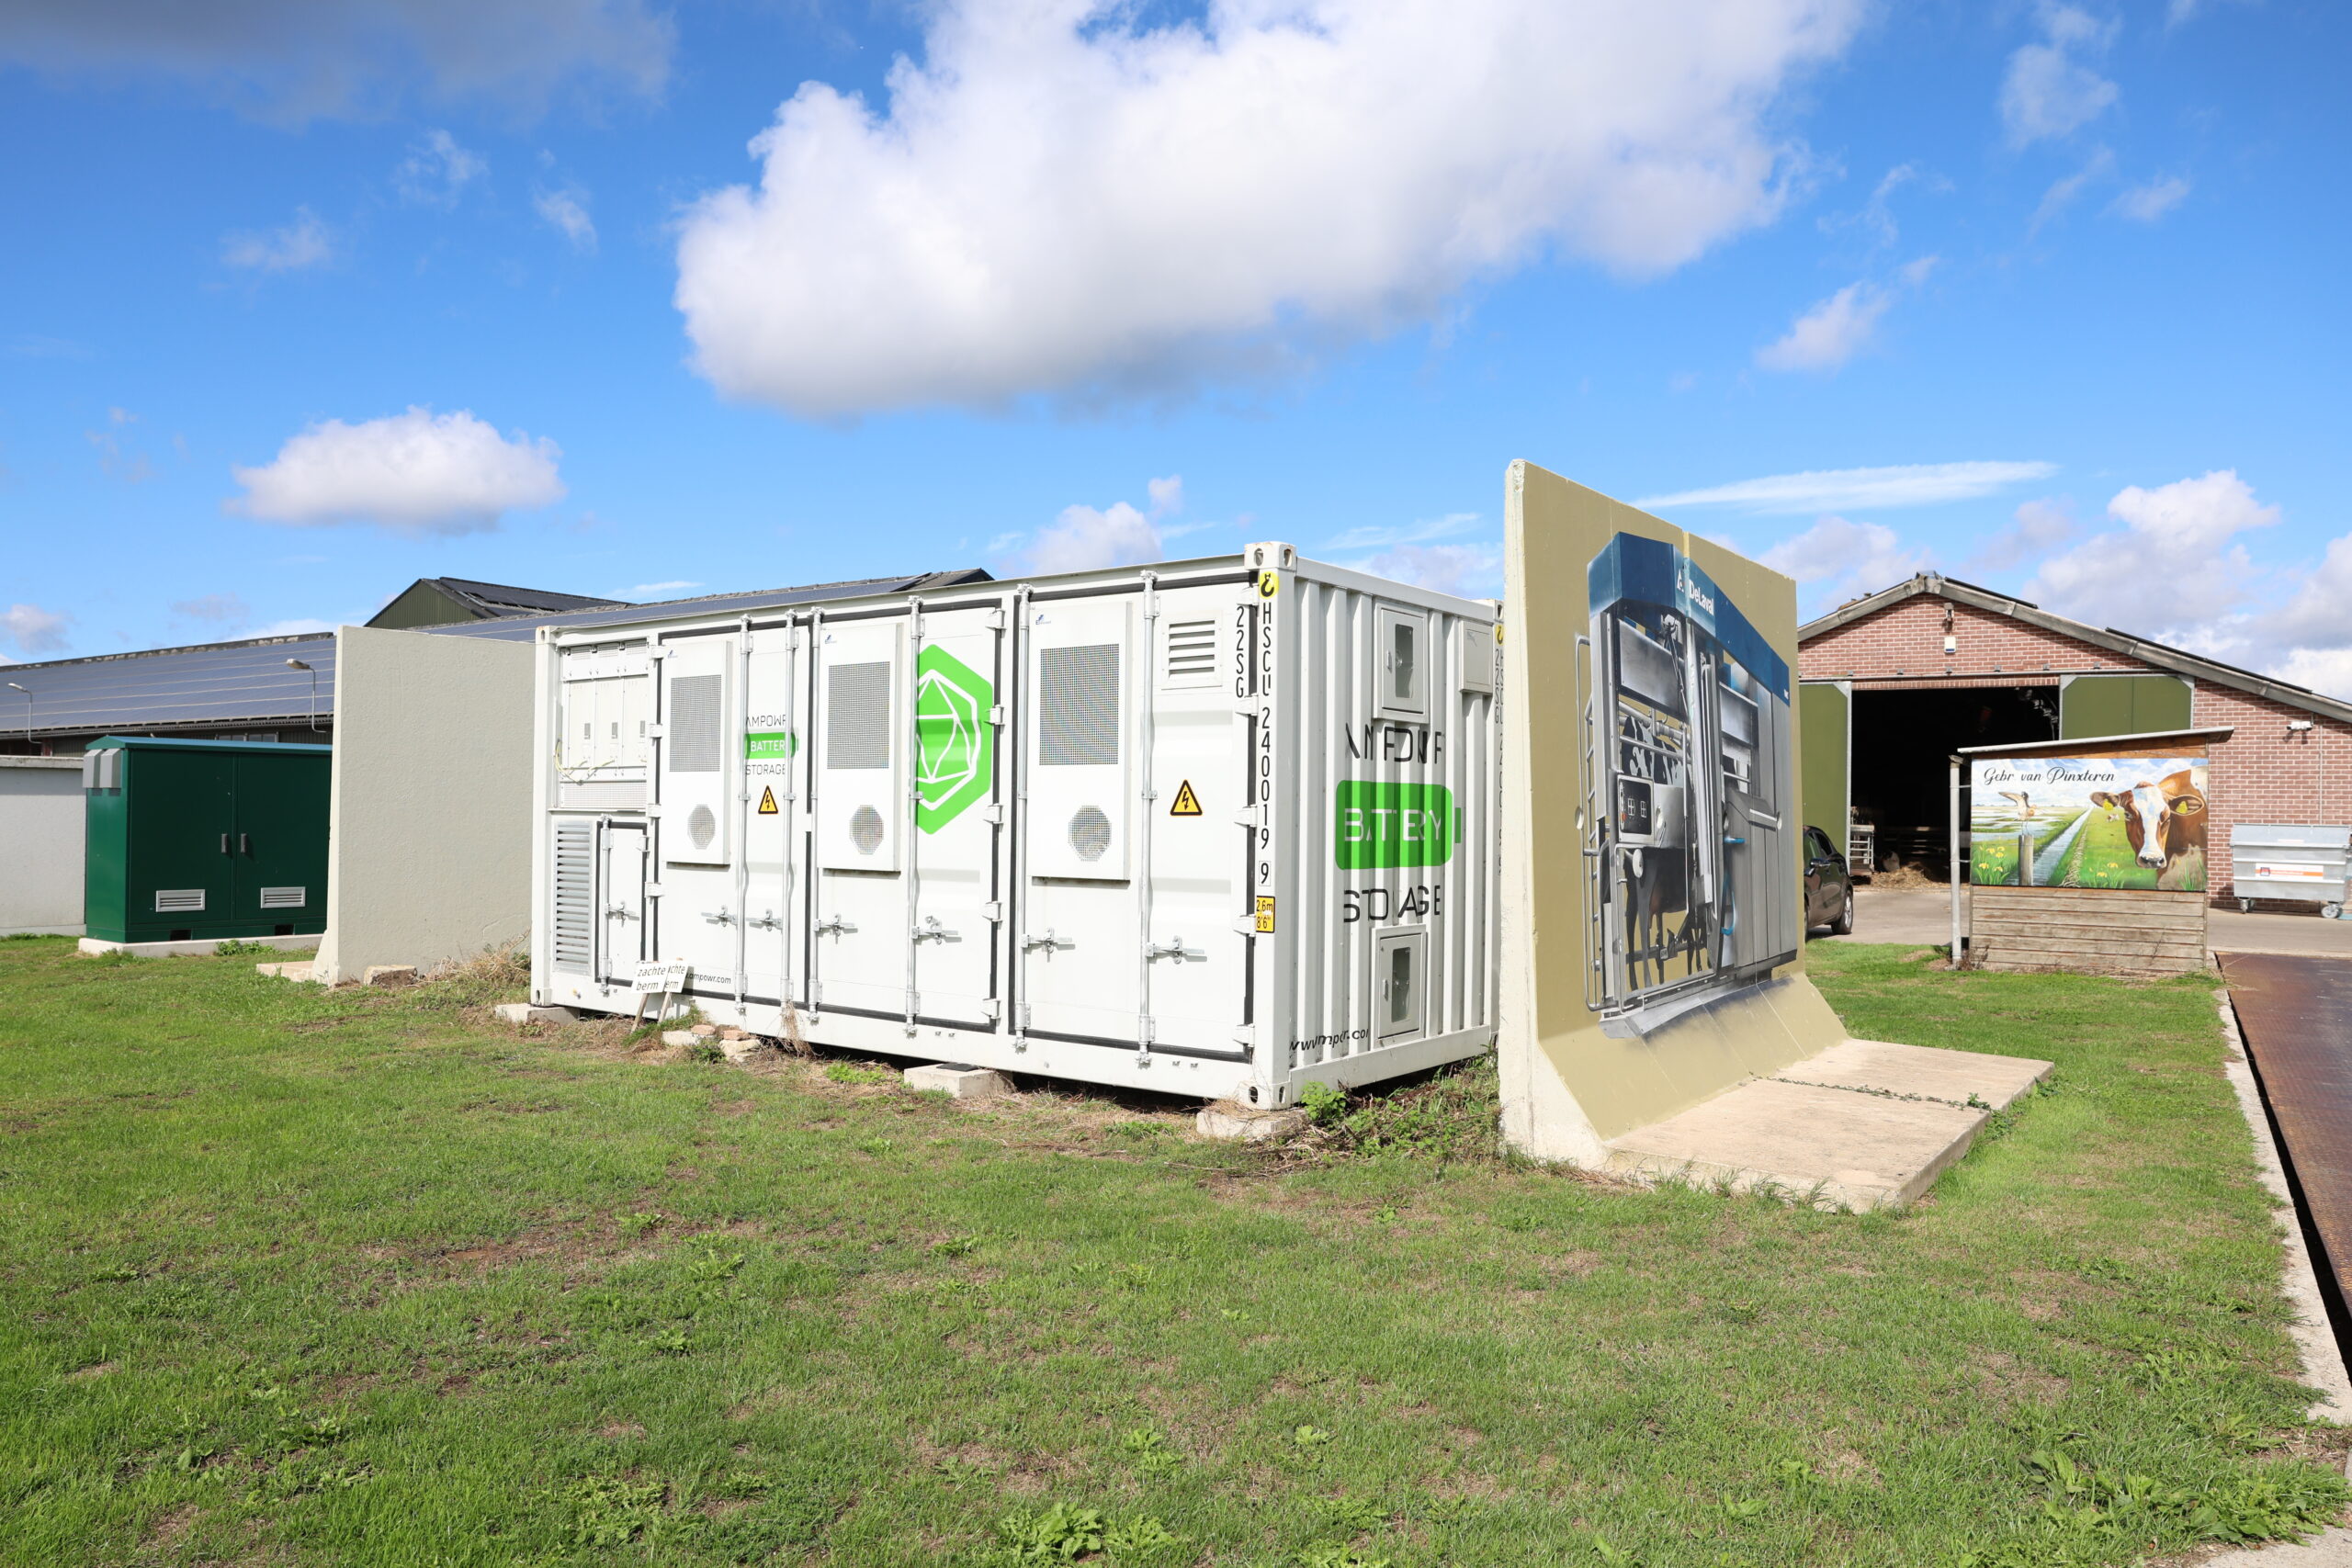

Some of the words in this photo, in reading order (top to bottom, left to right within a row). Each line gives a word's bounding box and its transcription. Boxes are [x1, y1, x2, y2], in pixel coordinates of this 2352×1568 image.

[1689, 579, 1714, 616] DeLaval
[1236, 605, 1245, 698] 22SG
[1262, 602, 1272, 696] HSCU
[750, 739, 786, 752] BATTER
[1261, 706, 1271, 850] 240019
[1984, 766, 2015, 786] Gebr
[2020, 773, 2041, 783] van
[2046, 766, 2116, 785] Pinxteren
[637, 966, 667, 977] zachte
[636, 981, 660, 991] berm
